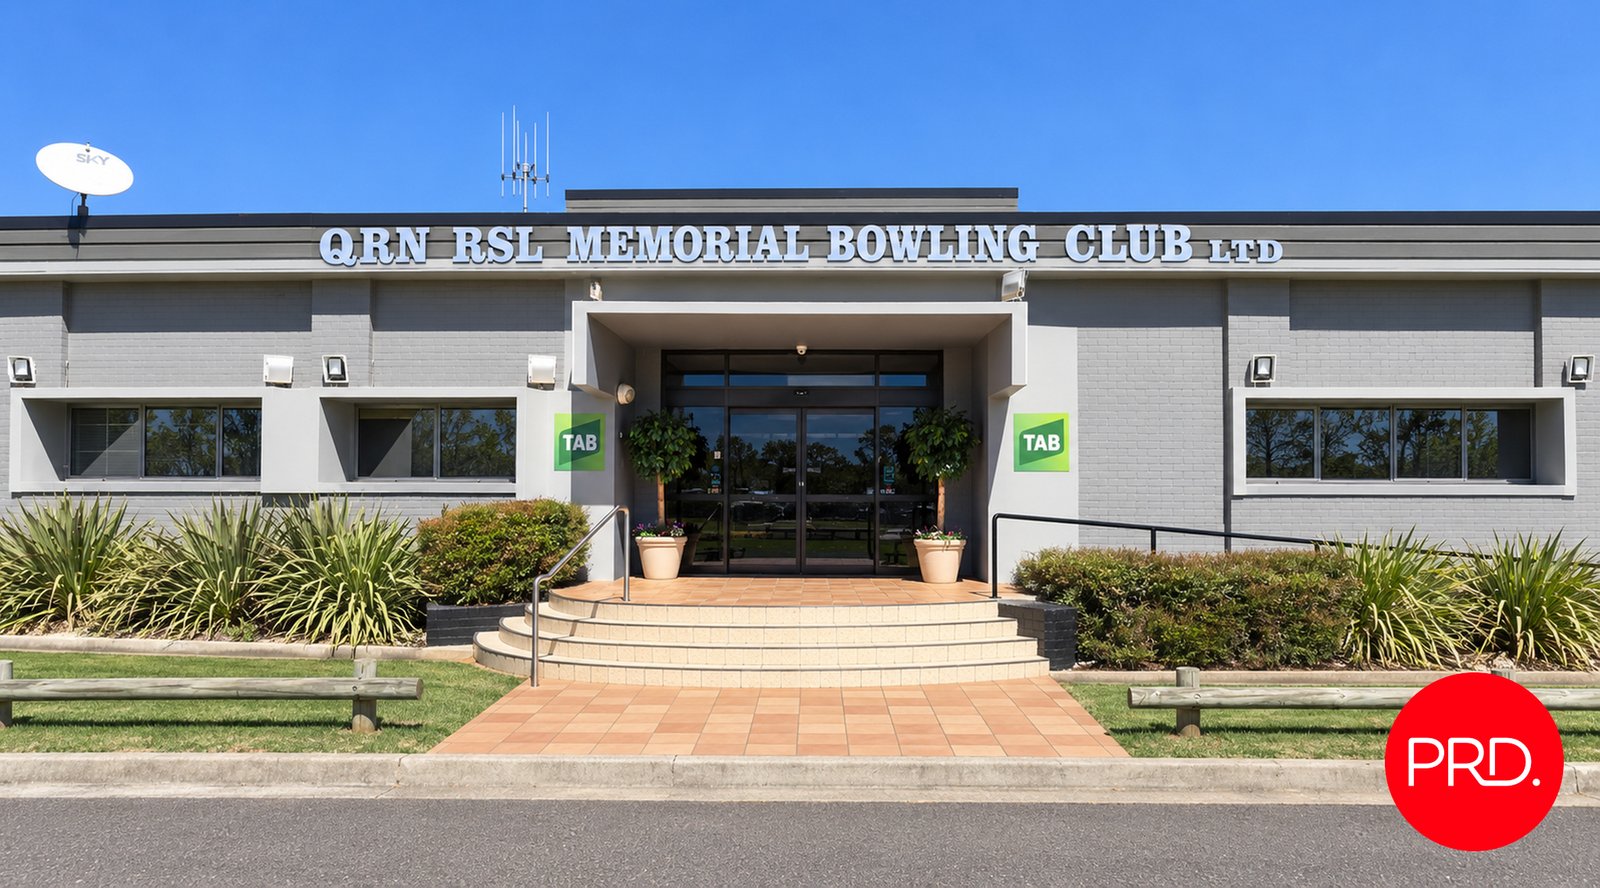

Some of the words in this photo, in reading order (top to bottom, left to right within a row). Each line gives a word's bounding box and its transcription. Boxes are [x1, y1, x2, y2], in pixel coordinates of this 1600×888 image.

[76, 153, 110, 166] SKY
[319, 227, 430, 267] QRN
[452, 226, 543, 264] RSL
[566, 225, 809, 263] MEMORIAL
[827, 224, 1040, 263] BOWLING
[1065, 224, 1193, 263] CLUB
[1208, 239, 1284, 264] LTD
[562, 434, 597, 451] TAB
[1023, 434, 1061, 451] TAB
